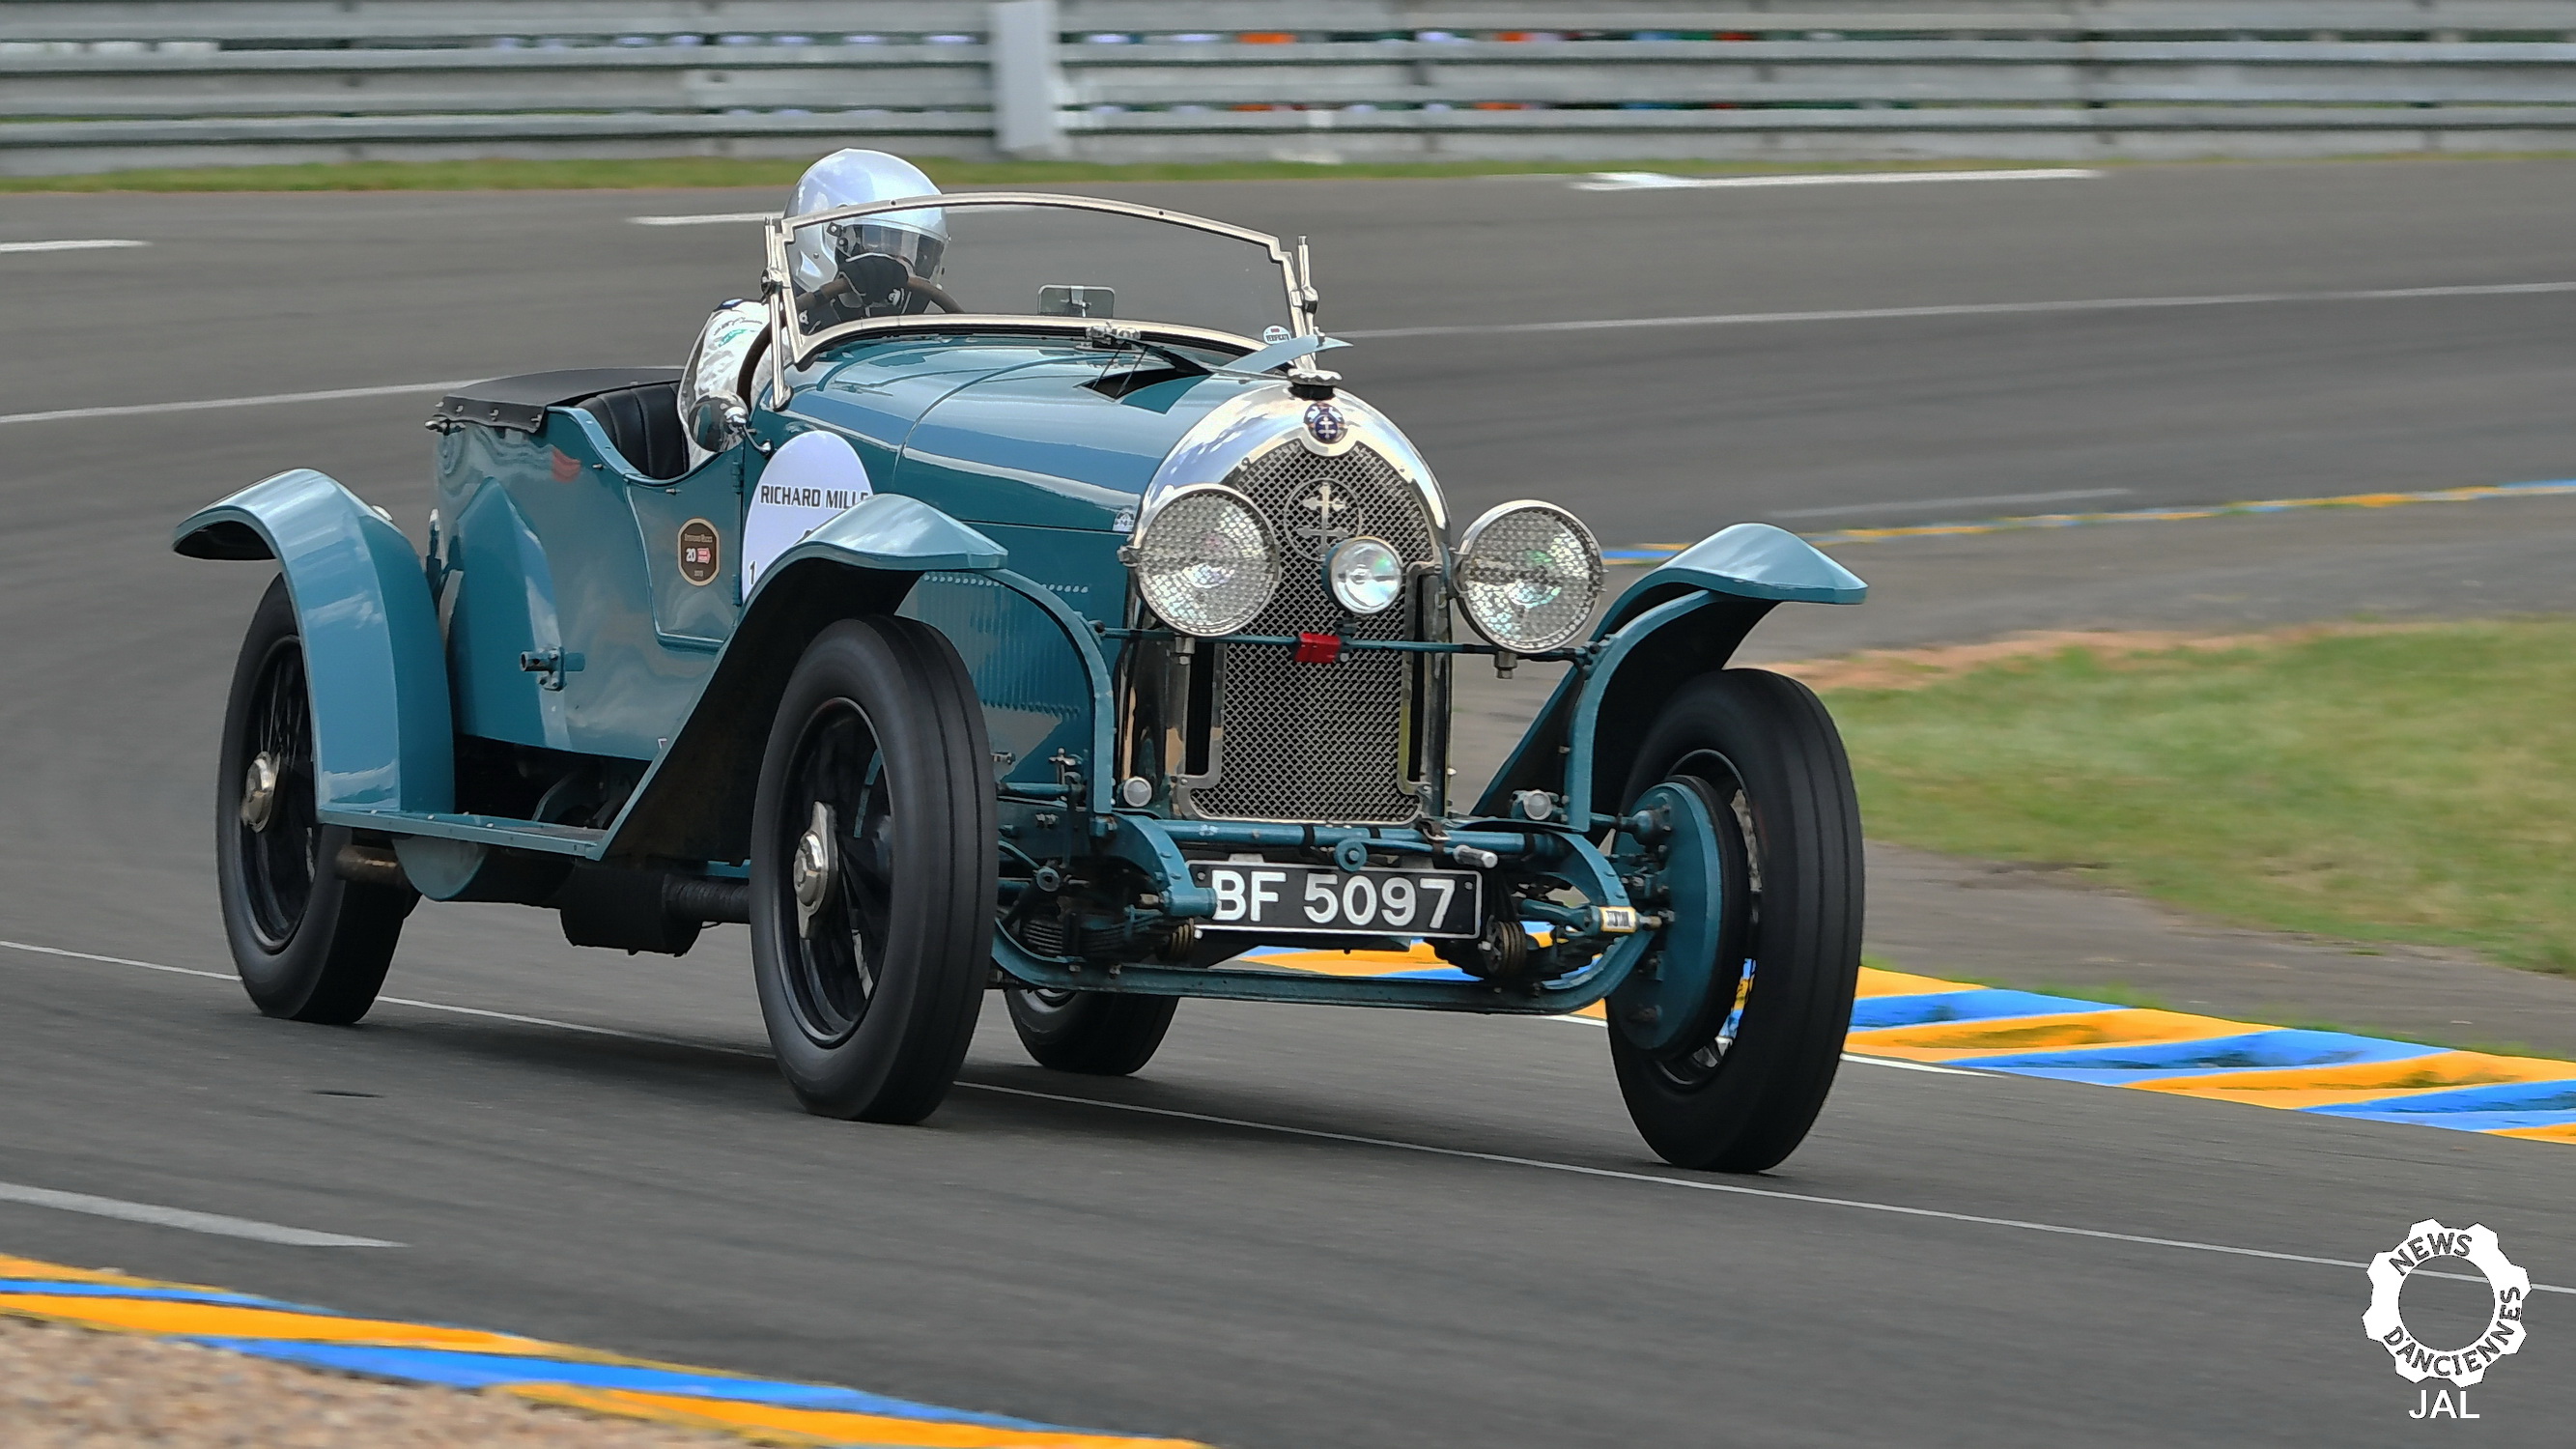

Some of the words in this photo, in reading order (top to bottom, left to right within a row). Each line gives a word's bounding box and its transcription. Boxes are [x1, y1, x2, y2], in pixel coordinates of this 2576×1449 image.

[760, 485, 821, 507] RICHARD
[1211, 869, 1287, 922] BF
[1304, 872, 1456, 928] 5097
